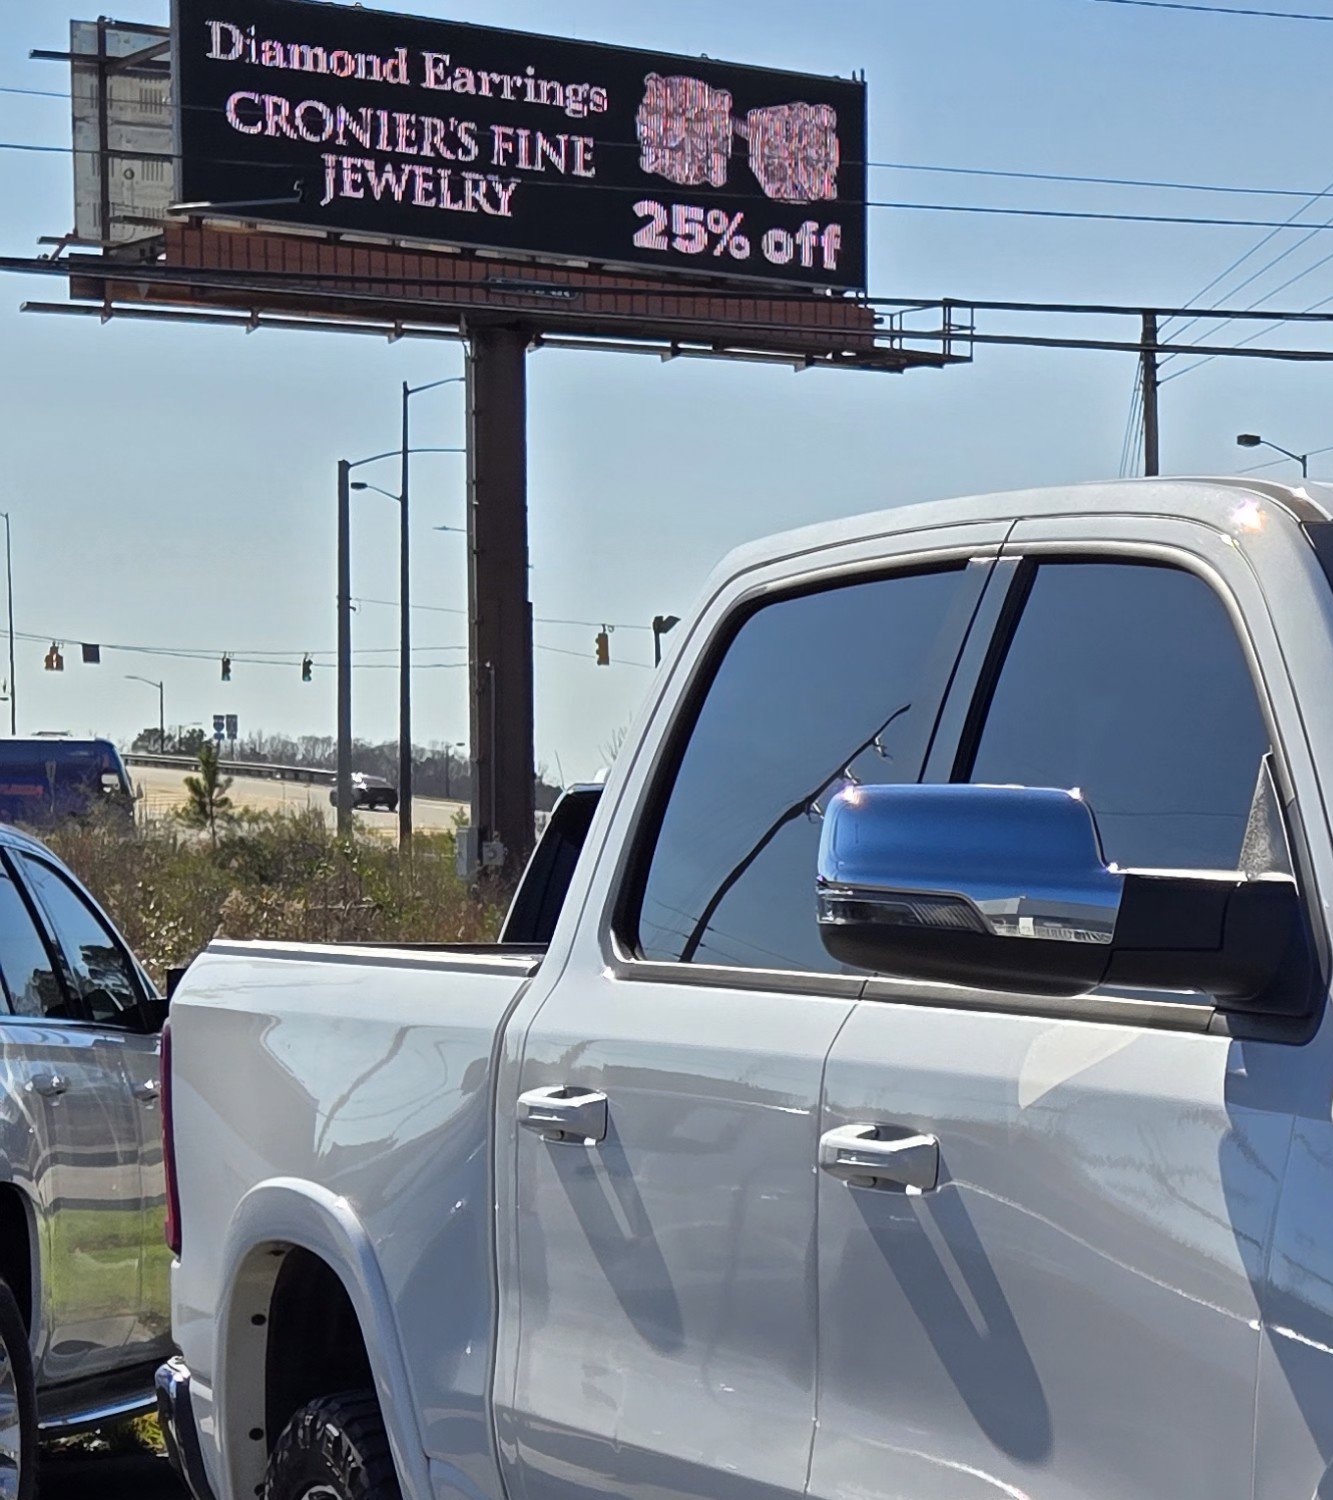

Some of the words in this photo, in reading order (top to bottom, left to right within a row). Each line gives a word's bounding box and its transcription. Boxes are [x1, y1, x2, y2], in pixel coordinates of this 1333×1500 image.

[205, 20, 410, 85] Diamond
[421, 50, 608, 118] Earrings
[225, 91, 479, 162] CRONIER'S
[490, 124, 596, 178] FINE
[319, 153, 522, 218] JEWELRY
[632, 199, 751, 260] 25%
[761, 220, 842, 271] off
